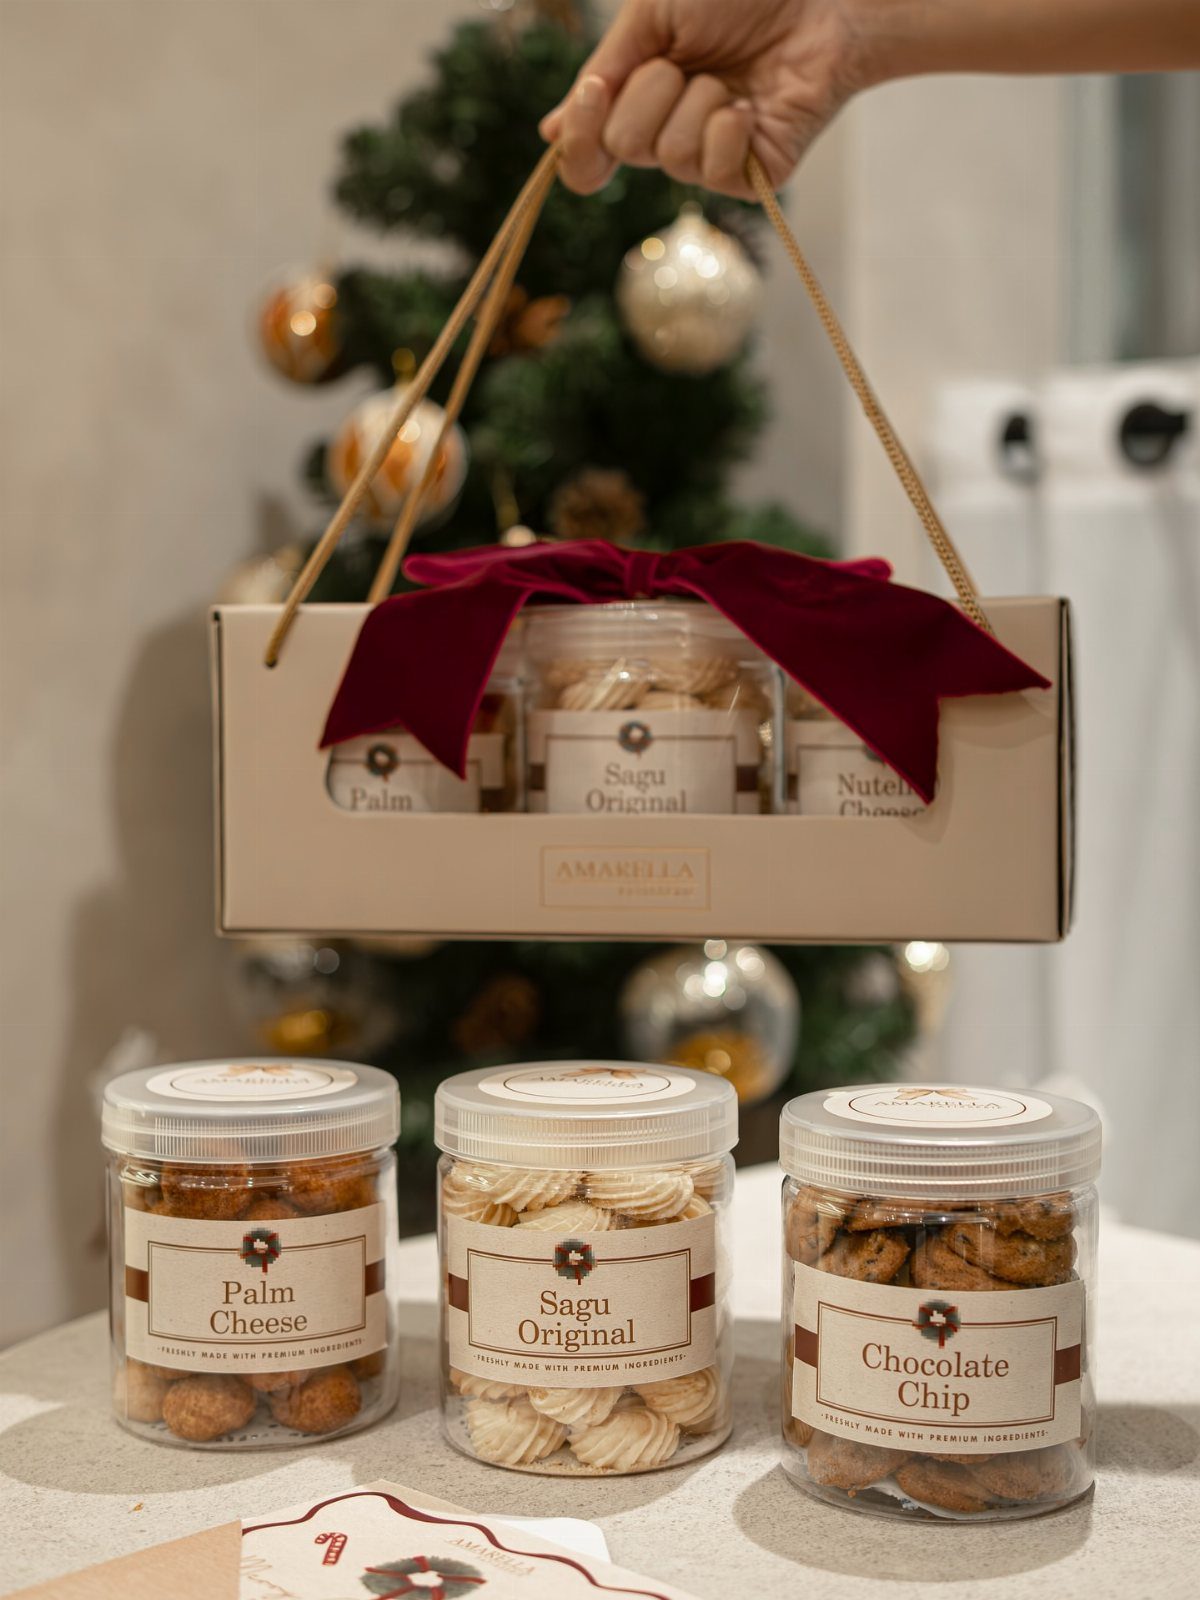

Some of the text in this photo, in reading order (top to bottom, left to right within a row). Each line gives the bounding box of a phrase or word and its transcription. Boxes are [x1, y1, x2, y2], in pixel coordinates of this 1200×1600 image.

[603, 761, 667, 794] Sagu
[349, 786, 413, 812] Palm
[584, 788, 688, 814] Original
[556, 861, 695, 879] AMARELLA
[874, 1101, 1002, 1109] AMARELLA
[221, 1280, 296, 1306] Palm
[540, 1290, 612, 1321] Sagu
[209, 1309, 309, 1335] Cheese
[161, 1346, 196, 1357] FRESHLY
[262, 1349, 305, 1359] PREMIUM
[310, 1338, 363, 1355] INGREDIENTS
[518, 1318, 636, 1353] Original
[477, 1353, 683, 1372] FRESHLY MADE WITH PREMIUM INGREDIENTS
[861, 1342, 1010, 1378] Chocolate
[898, 1380, 970, 1416] Chip
[825, 1413, 1045, 1443] FRESHLY MADE WITH PREMIUM INGREDIENTS
